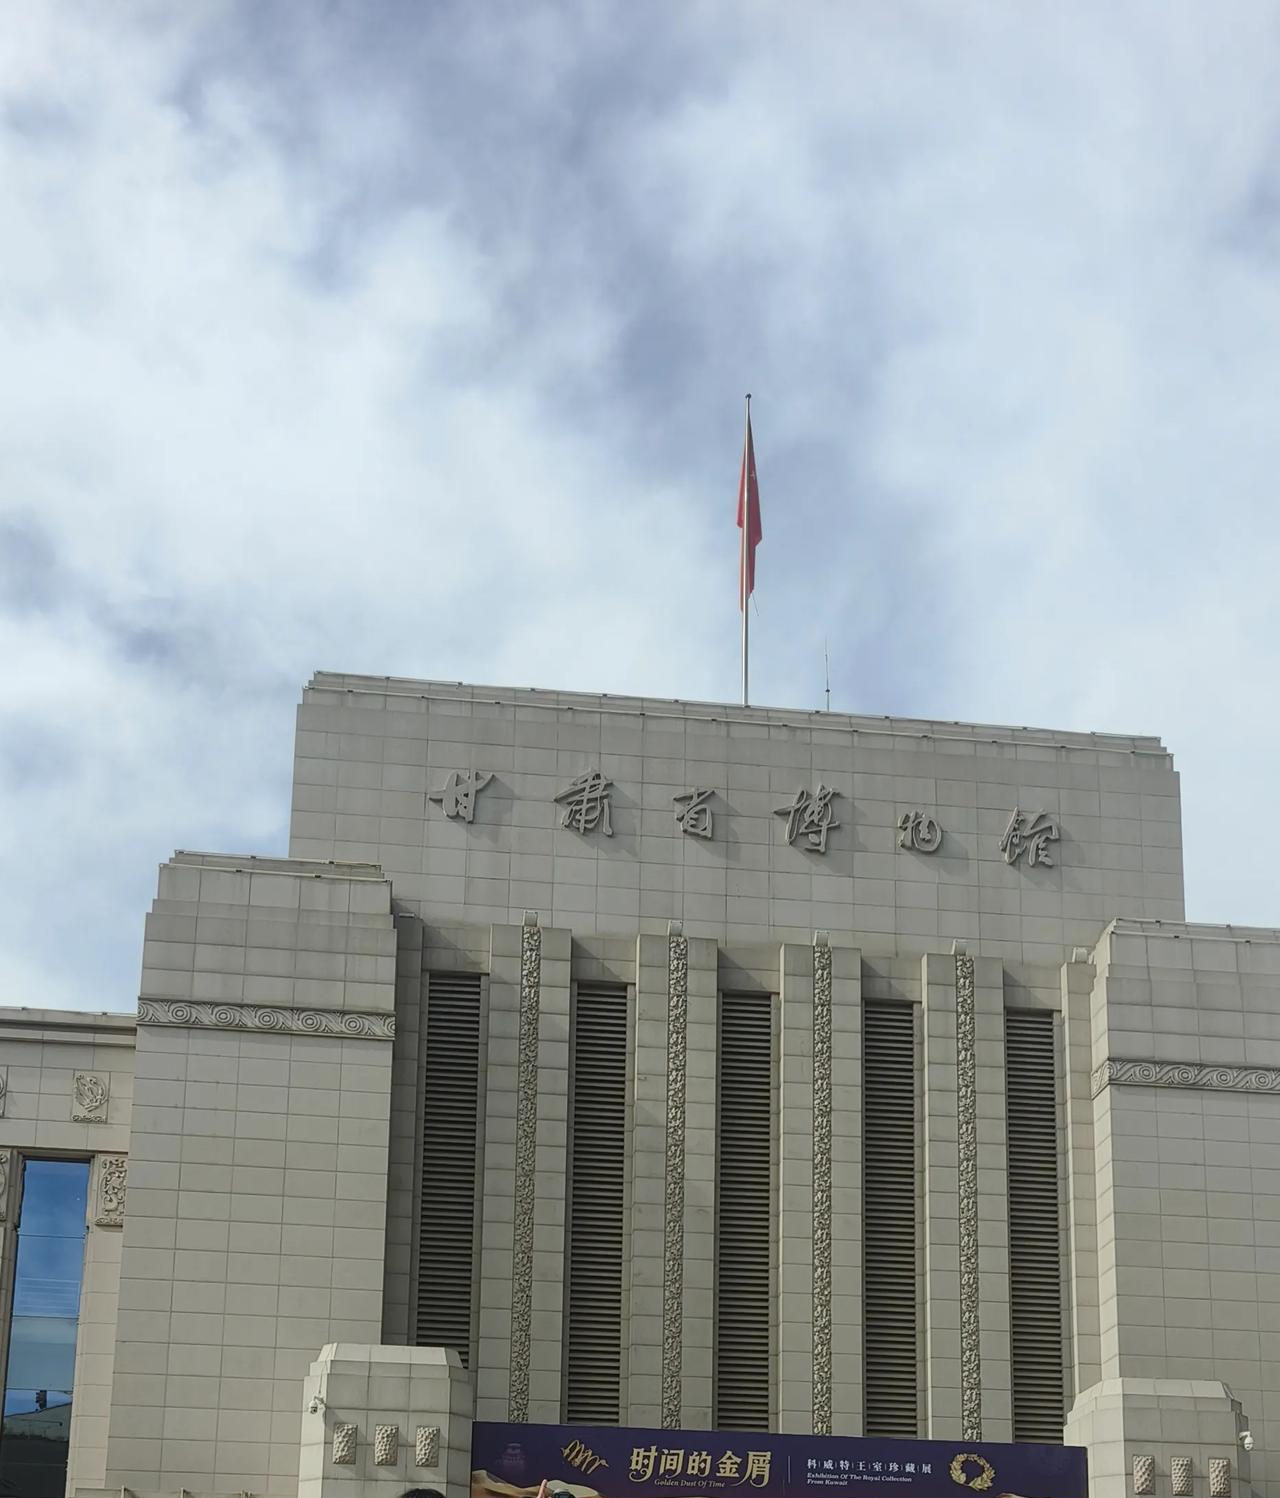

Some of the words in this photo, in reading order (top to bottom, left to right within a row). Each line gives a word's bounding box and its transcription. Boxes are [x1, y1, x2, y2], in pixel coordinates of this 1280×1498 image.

[629, 1445, 771, 1488] 时间的金屑
[807, 1472, 839, 1480] Exhibition
[654, 1479, 679, 1487] Golden
[681, 1479, 697, 1487] Dust
[698, 1480, 707, 1489] Of
